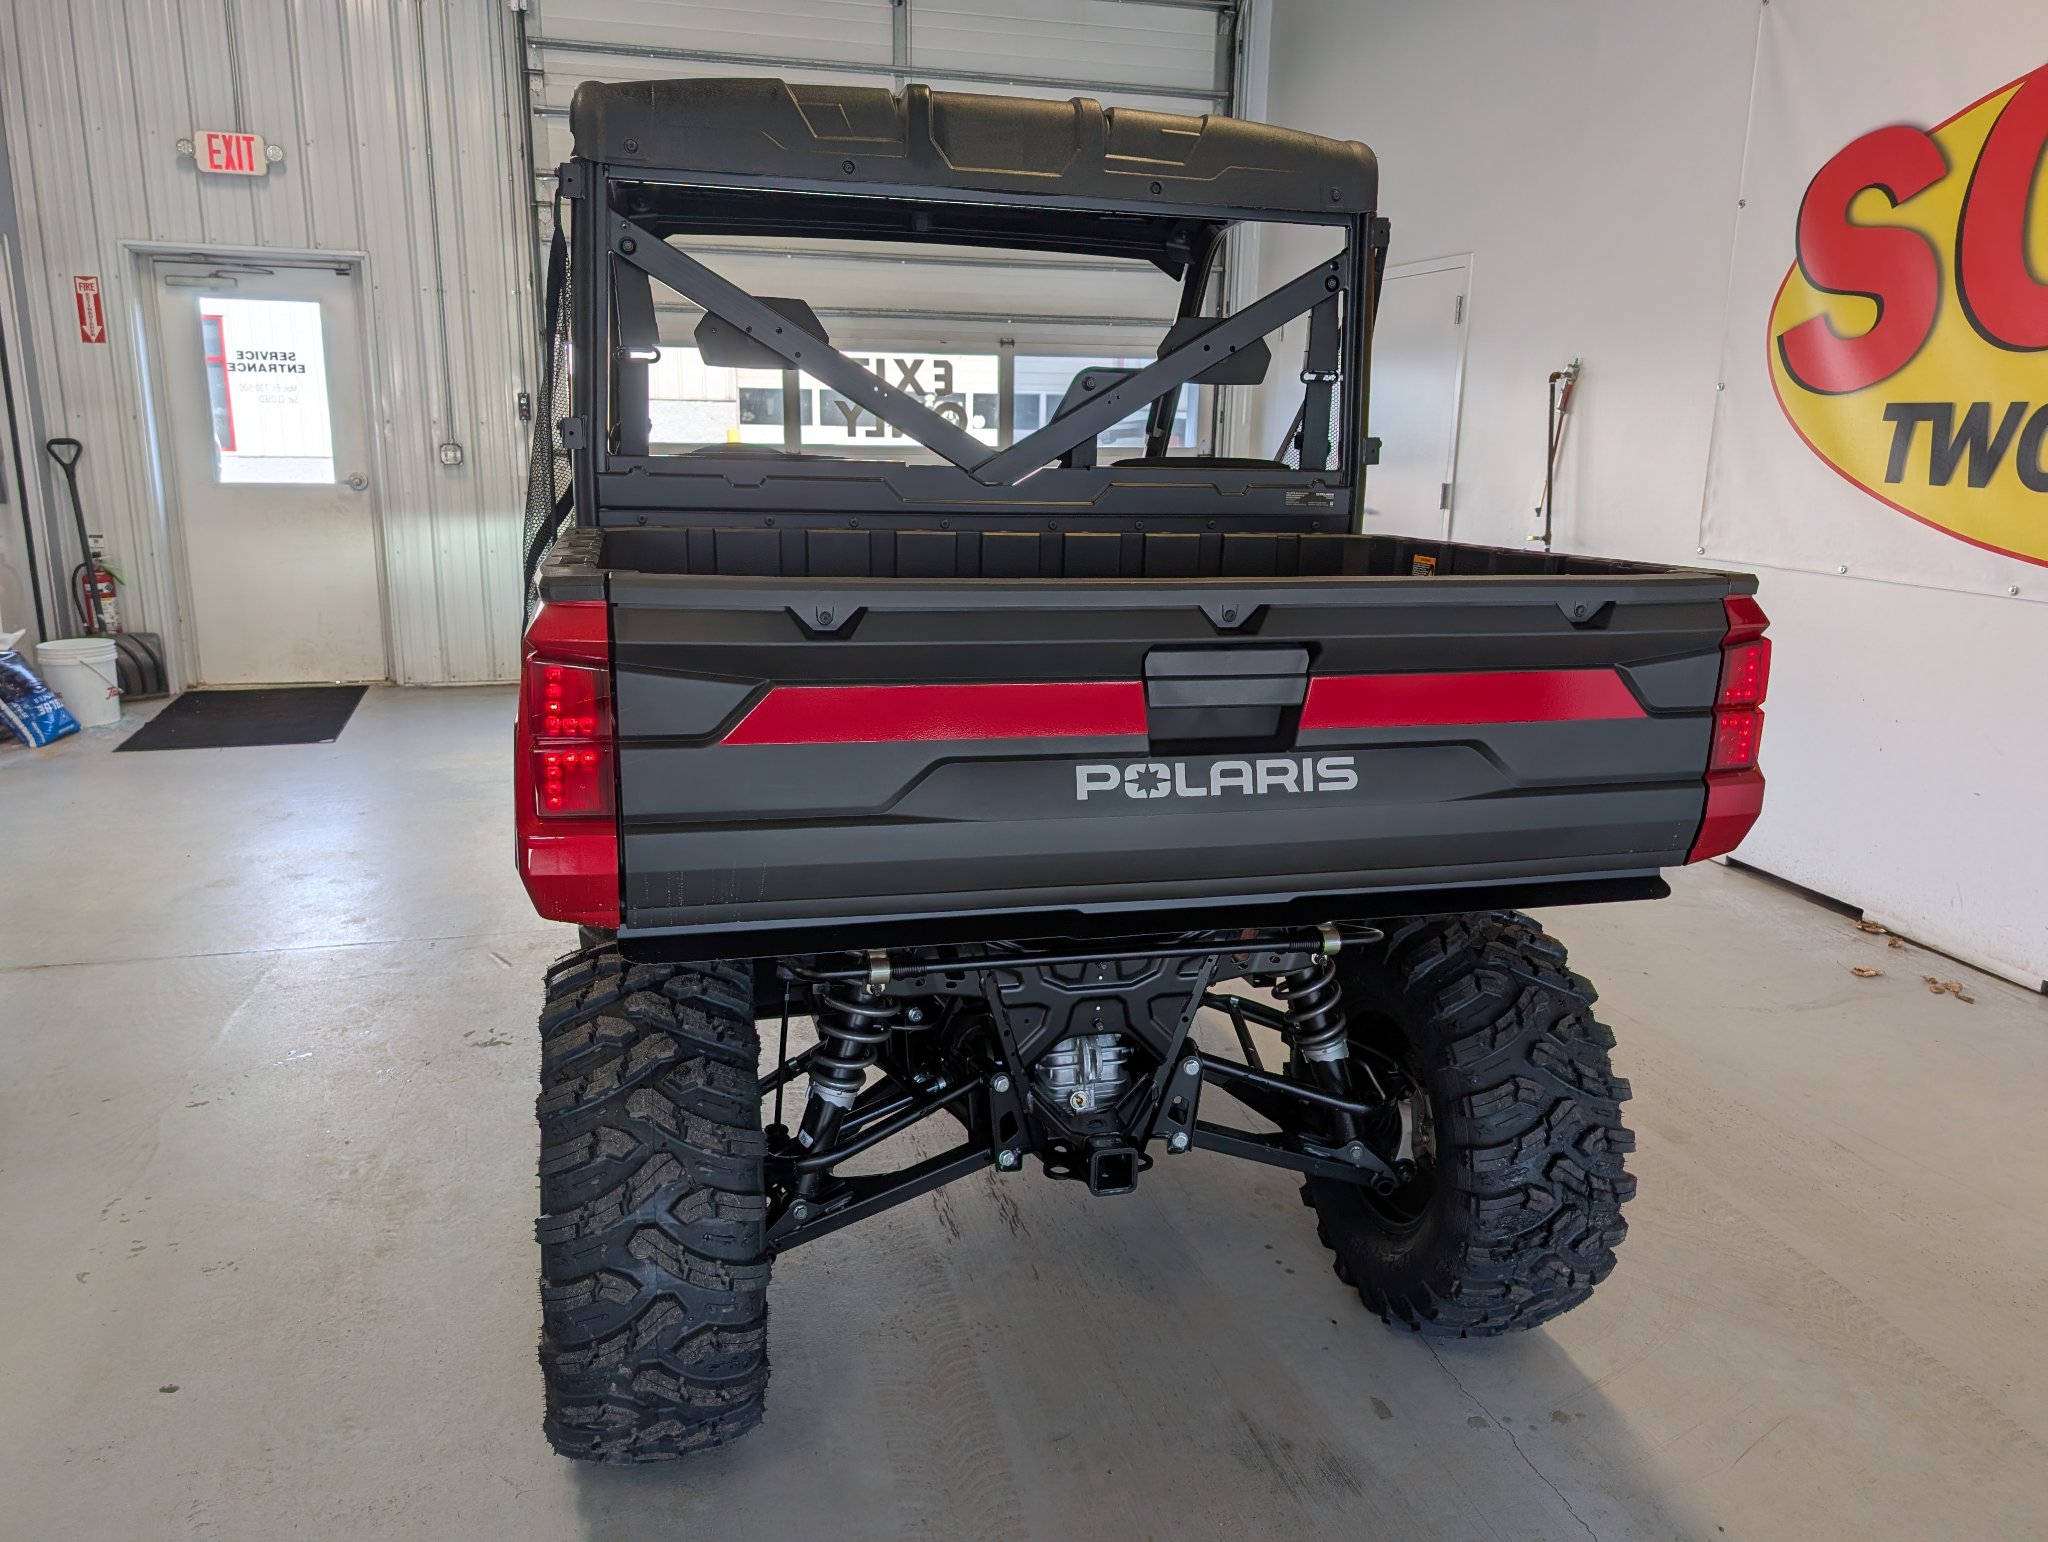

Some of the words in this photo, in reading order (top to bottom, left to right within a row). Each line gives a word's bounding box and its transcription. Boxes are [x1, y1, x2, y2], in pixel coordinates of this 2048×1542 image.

[207, 133, 254, 172] EXIT
[79, 282, 96, 292] FIRE
[1075, 756, 1359, 801] POLARIS
